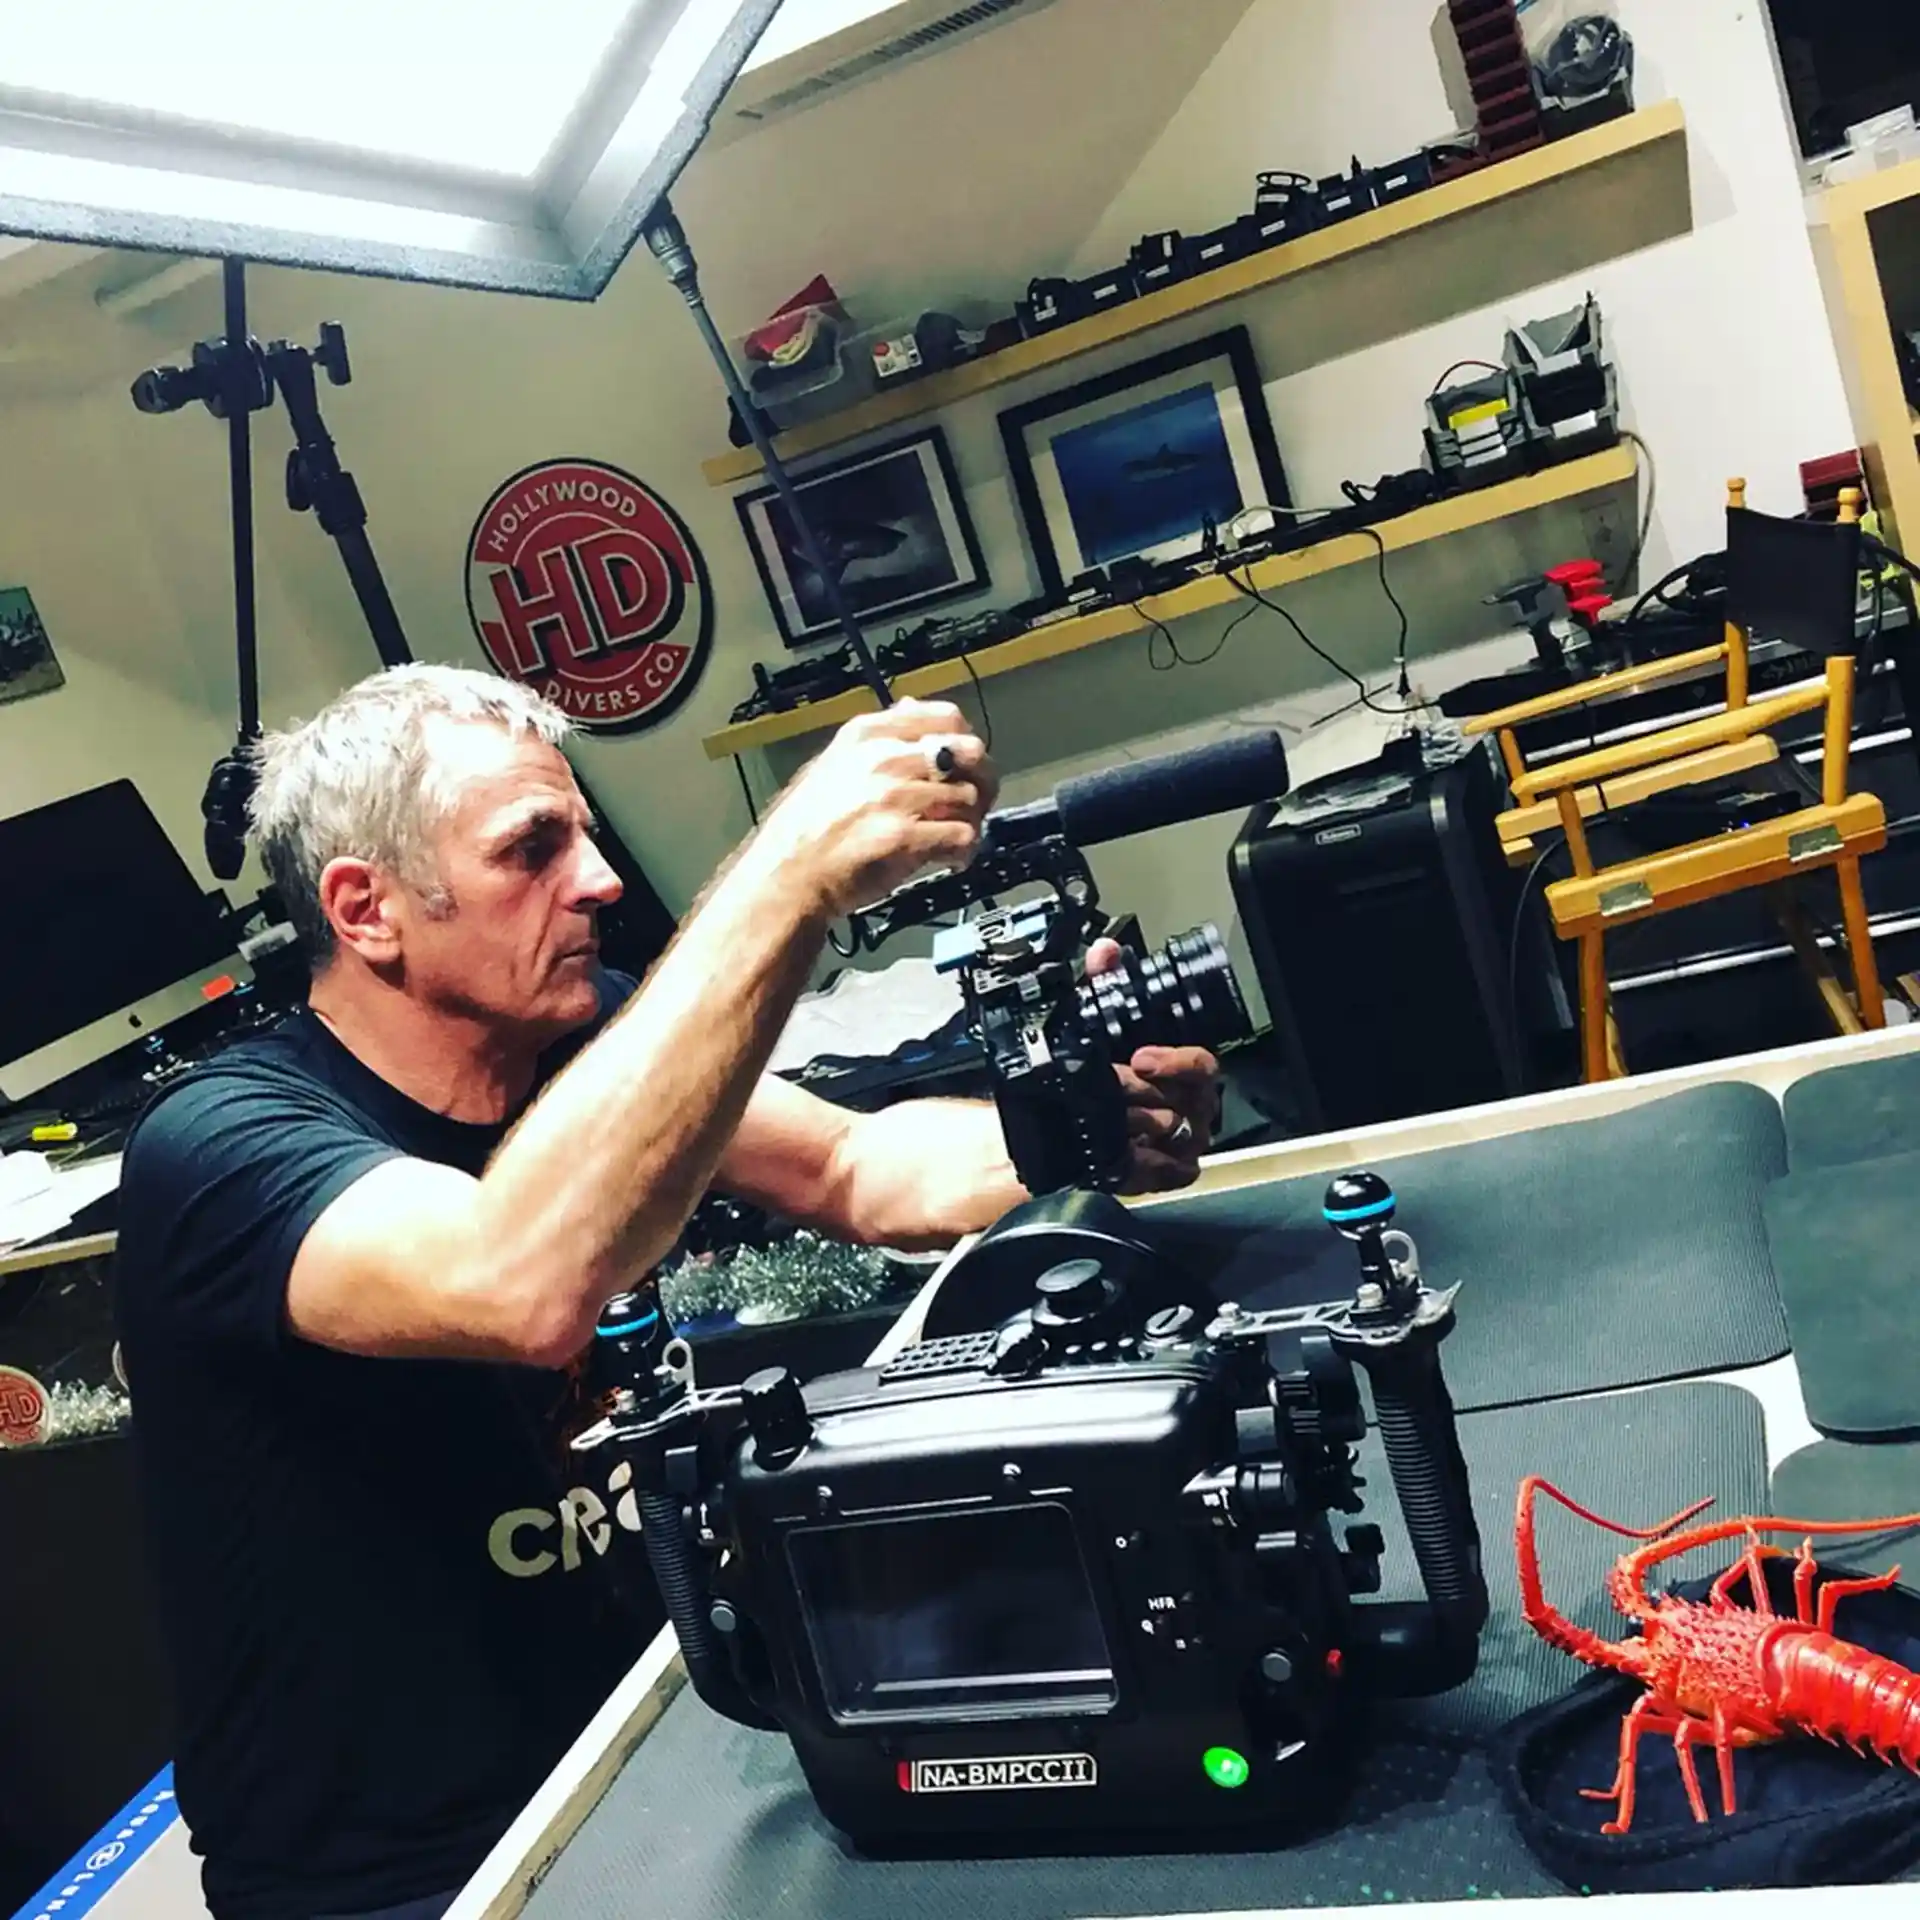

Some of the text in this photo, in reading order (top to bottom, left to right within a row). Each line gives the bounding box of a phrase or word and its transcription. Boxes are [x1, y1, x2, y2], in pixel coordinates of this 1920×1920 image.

[488, 480, 637, 552] HOLLYWOOD
[489, 528, 673, 674] HD
[545, 680, 641, 712] DIVERS
[923, 1759, 1087, 1787] NA-BMPCCII
